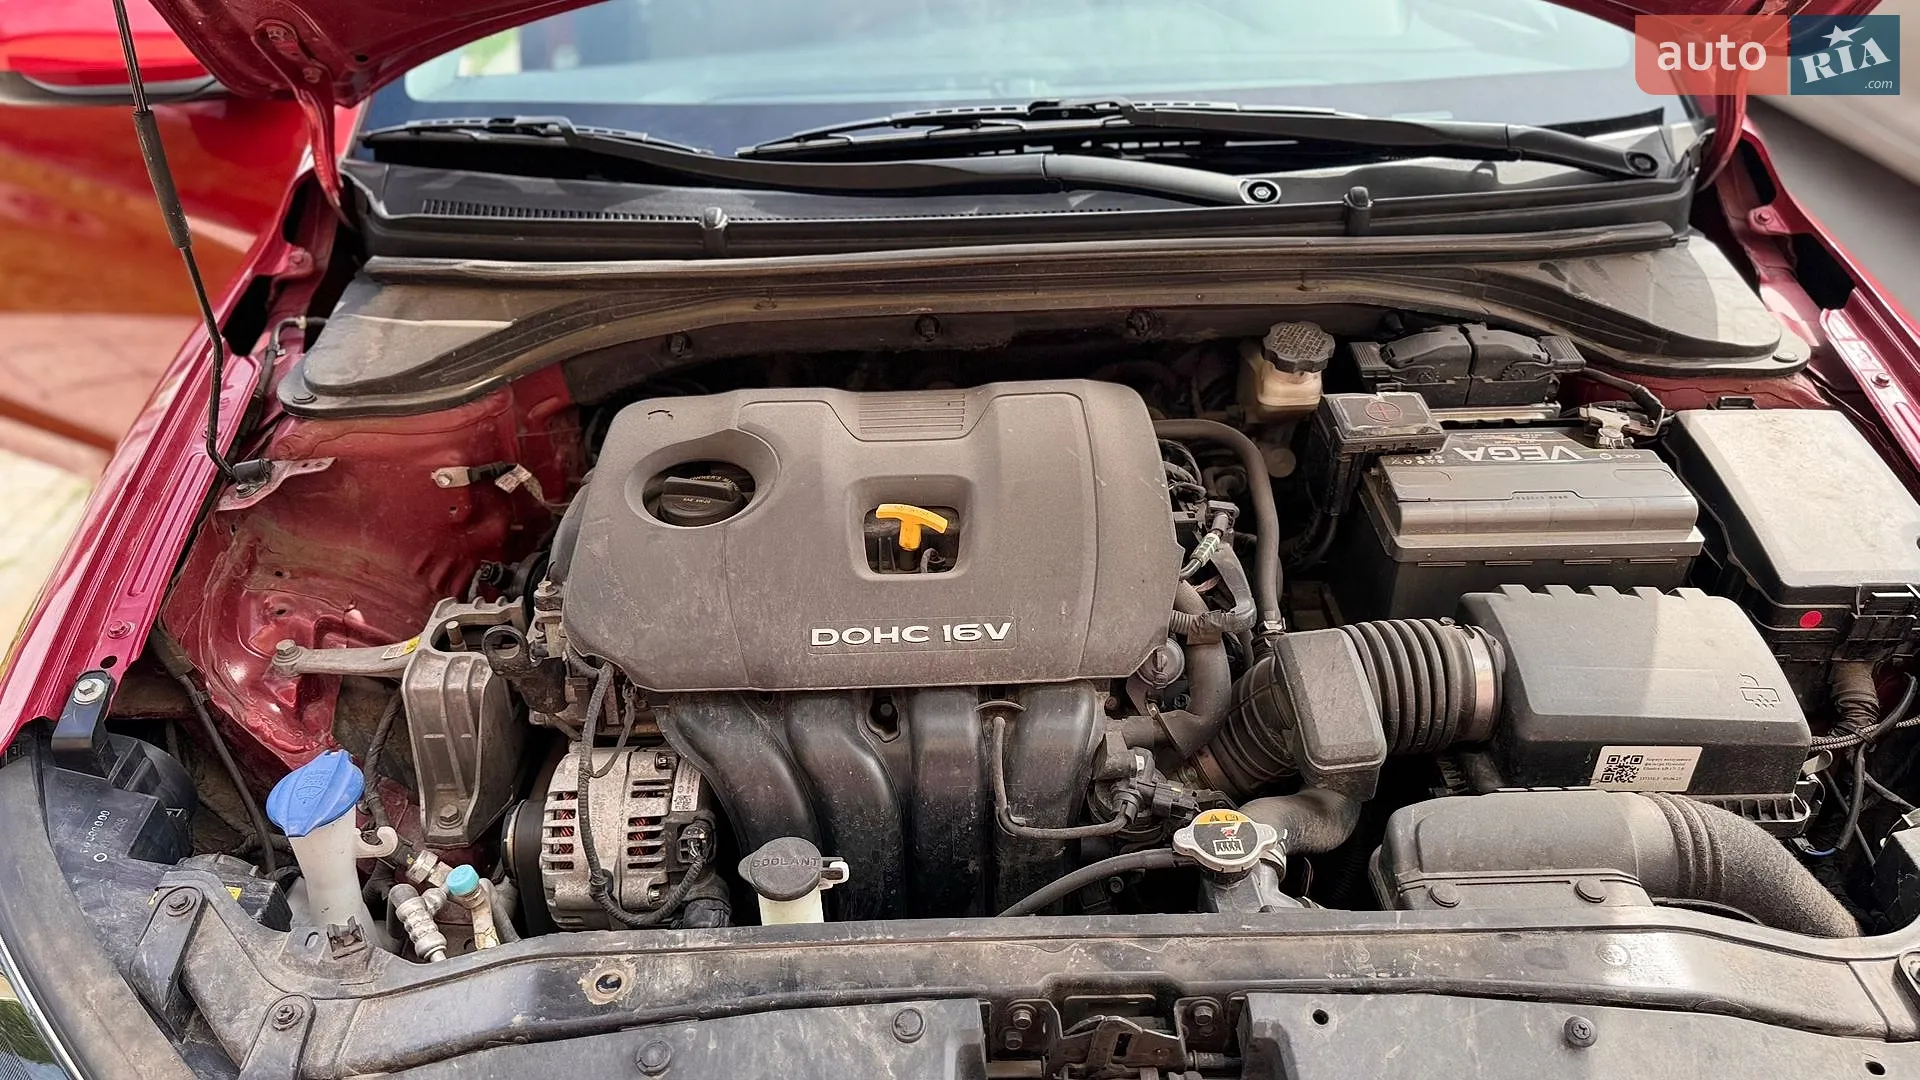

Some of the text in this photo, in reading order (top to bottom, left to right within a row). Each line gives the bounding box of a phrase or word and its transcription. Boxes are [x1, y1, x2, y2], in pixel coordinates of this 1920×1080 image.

[1452, 445, 1584, 462] VEGA
[811, 622, 1012, 646] DOHC 16V
[752, 857, 819, 868] COOLANT
